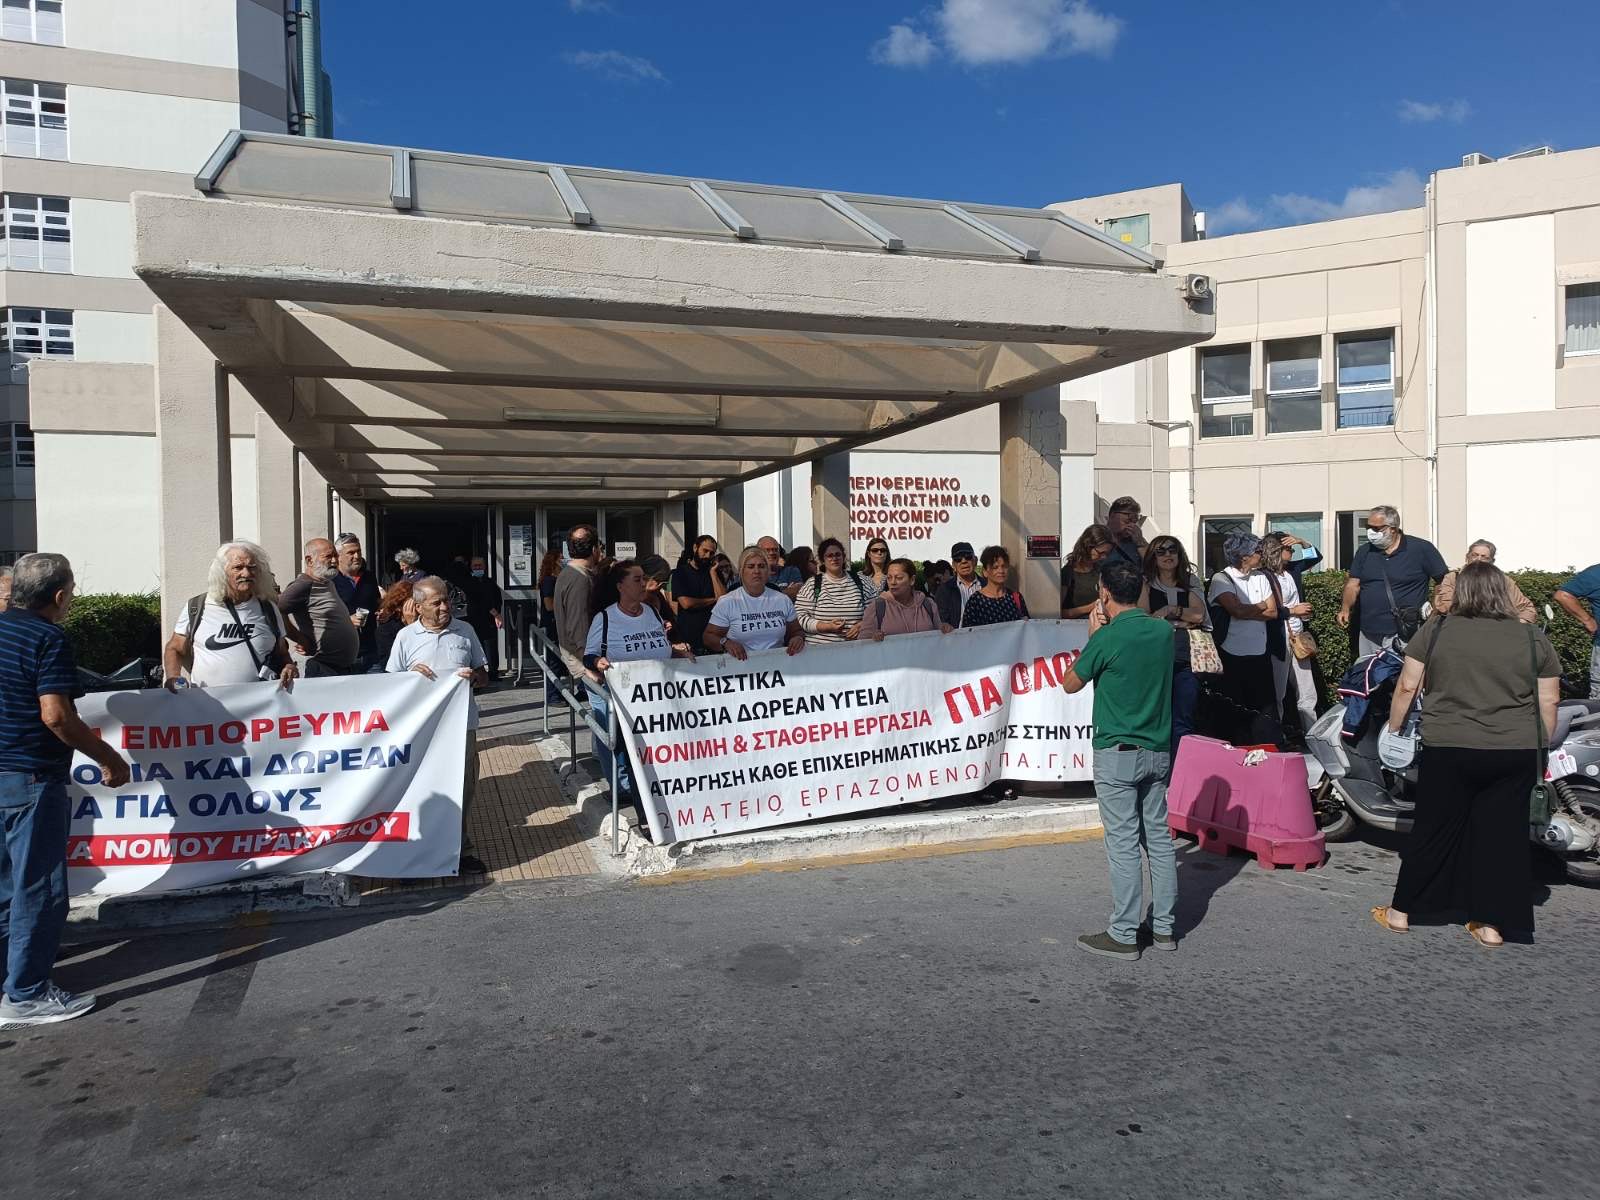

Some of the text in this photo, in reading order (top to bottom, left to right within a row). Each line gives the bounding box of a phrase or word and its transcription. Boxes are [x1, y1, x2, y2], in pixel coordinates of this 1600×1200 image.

[216, 623, 256, 639] NIKE
[630, 669, 786, 704] ΑΠΟΚΛΕΙΣΤΙΚΑ
[943, 648, 1081, 725] ΓΙΑ ΟΛΟ
[121, 709, 390, 750] ΕΜΠΟΡΕΥΜΑ
[632, 686, 889, 735] ΔΗΜΟΣΙΑ ΔΩΡΕΑΝ ΥΓΕΙΑ
[733, 734, 748, 754] &
[752, 720, 849, 751] ΣΤΑΘΕΡΗ
[853, 709, 932, 739] ΕΡΓΑΣΙΑ
[184, 755, 252, 780] ΚΑΙ
[263, 743, 412, 776] ΔΩΡΕΑΝ
[748, 763, 799, 790] ΚΑΘΕ
[803, 737, 962, 781] ΕΠΙΧΕΙΡΗΜΑΤΙΚΗΣ
[965, 724, 1018, 750] ΔΡΑΣΗΣ
[1023, 725, 1071, 740] ΣΤΗΝ
[115, 794, 179, 819] ΓΙΑ
[188, 786, 322, 818] ΟΛΟΥΣ
[800, 759, 992, 808] ΕΡΓΑΖΟΜΕΝΩΝ
[104, 836, 223, 860] ΝΟΜΟΥ
[230, 815, 397, 855] ΗΡΑΚΛΕΙΟΥ
